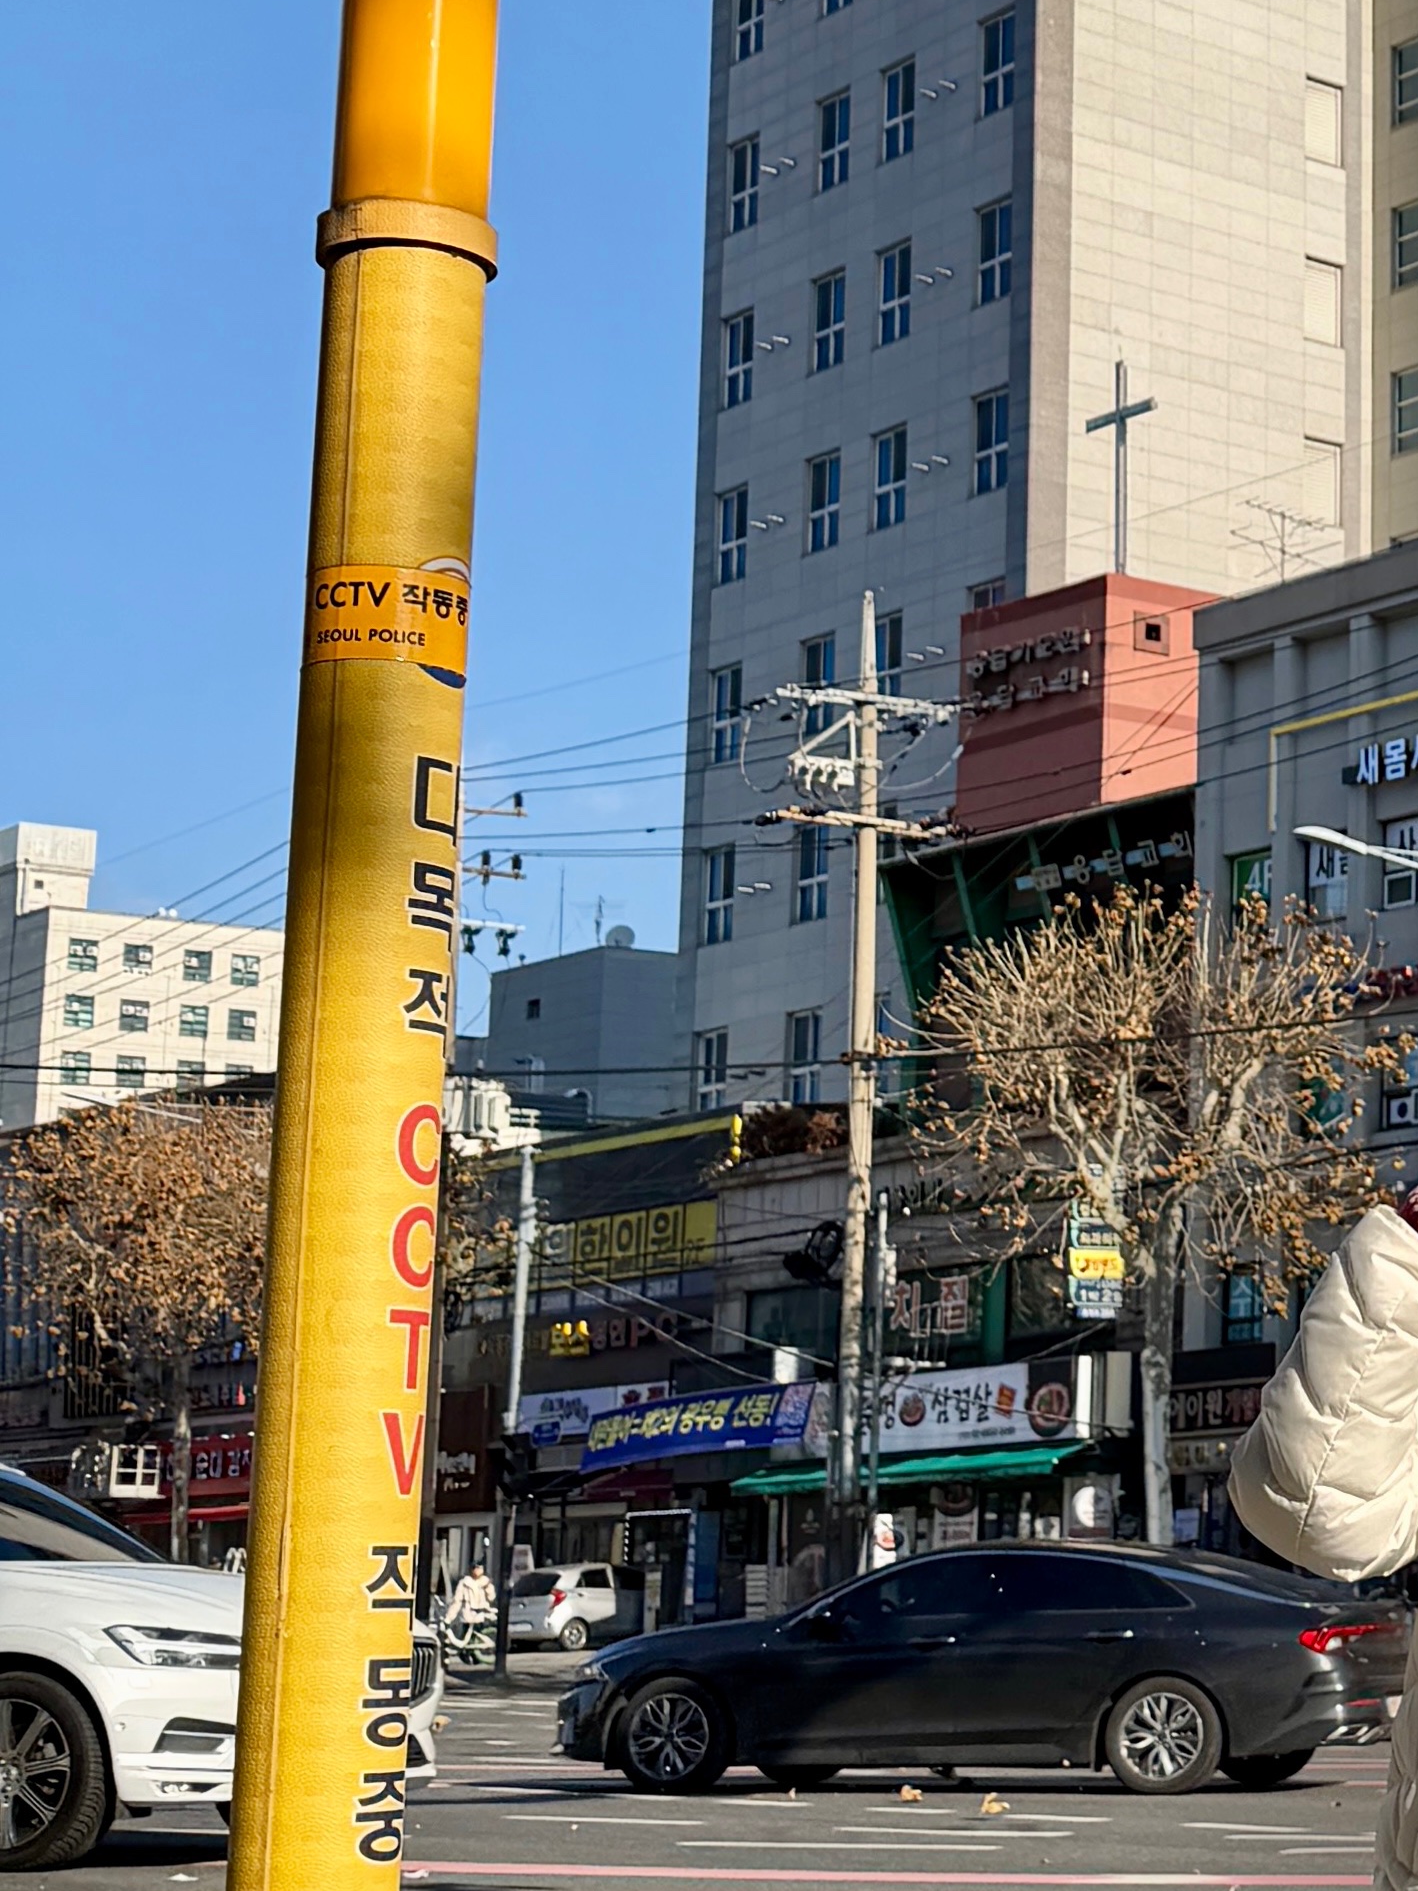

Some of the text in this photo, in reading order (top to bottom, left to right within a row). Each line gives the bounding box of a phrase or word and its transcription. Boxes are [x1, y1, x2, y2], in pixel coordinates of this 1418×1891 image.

[314, 580, 391, 611] CCTV
[316, 626, 426, 648] SEOUL POLICE
[931, 1381, 992, 1424] 삼겹살
